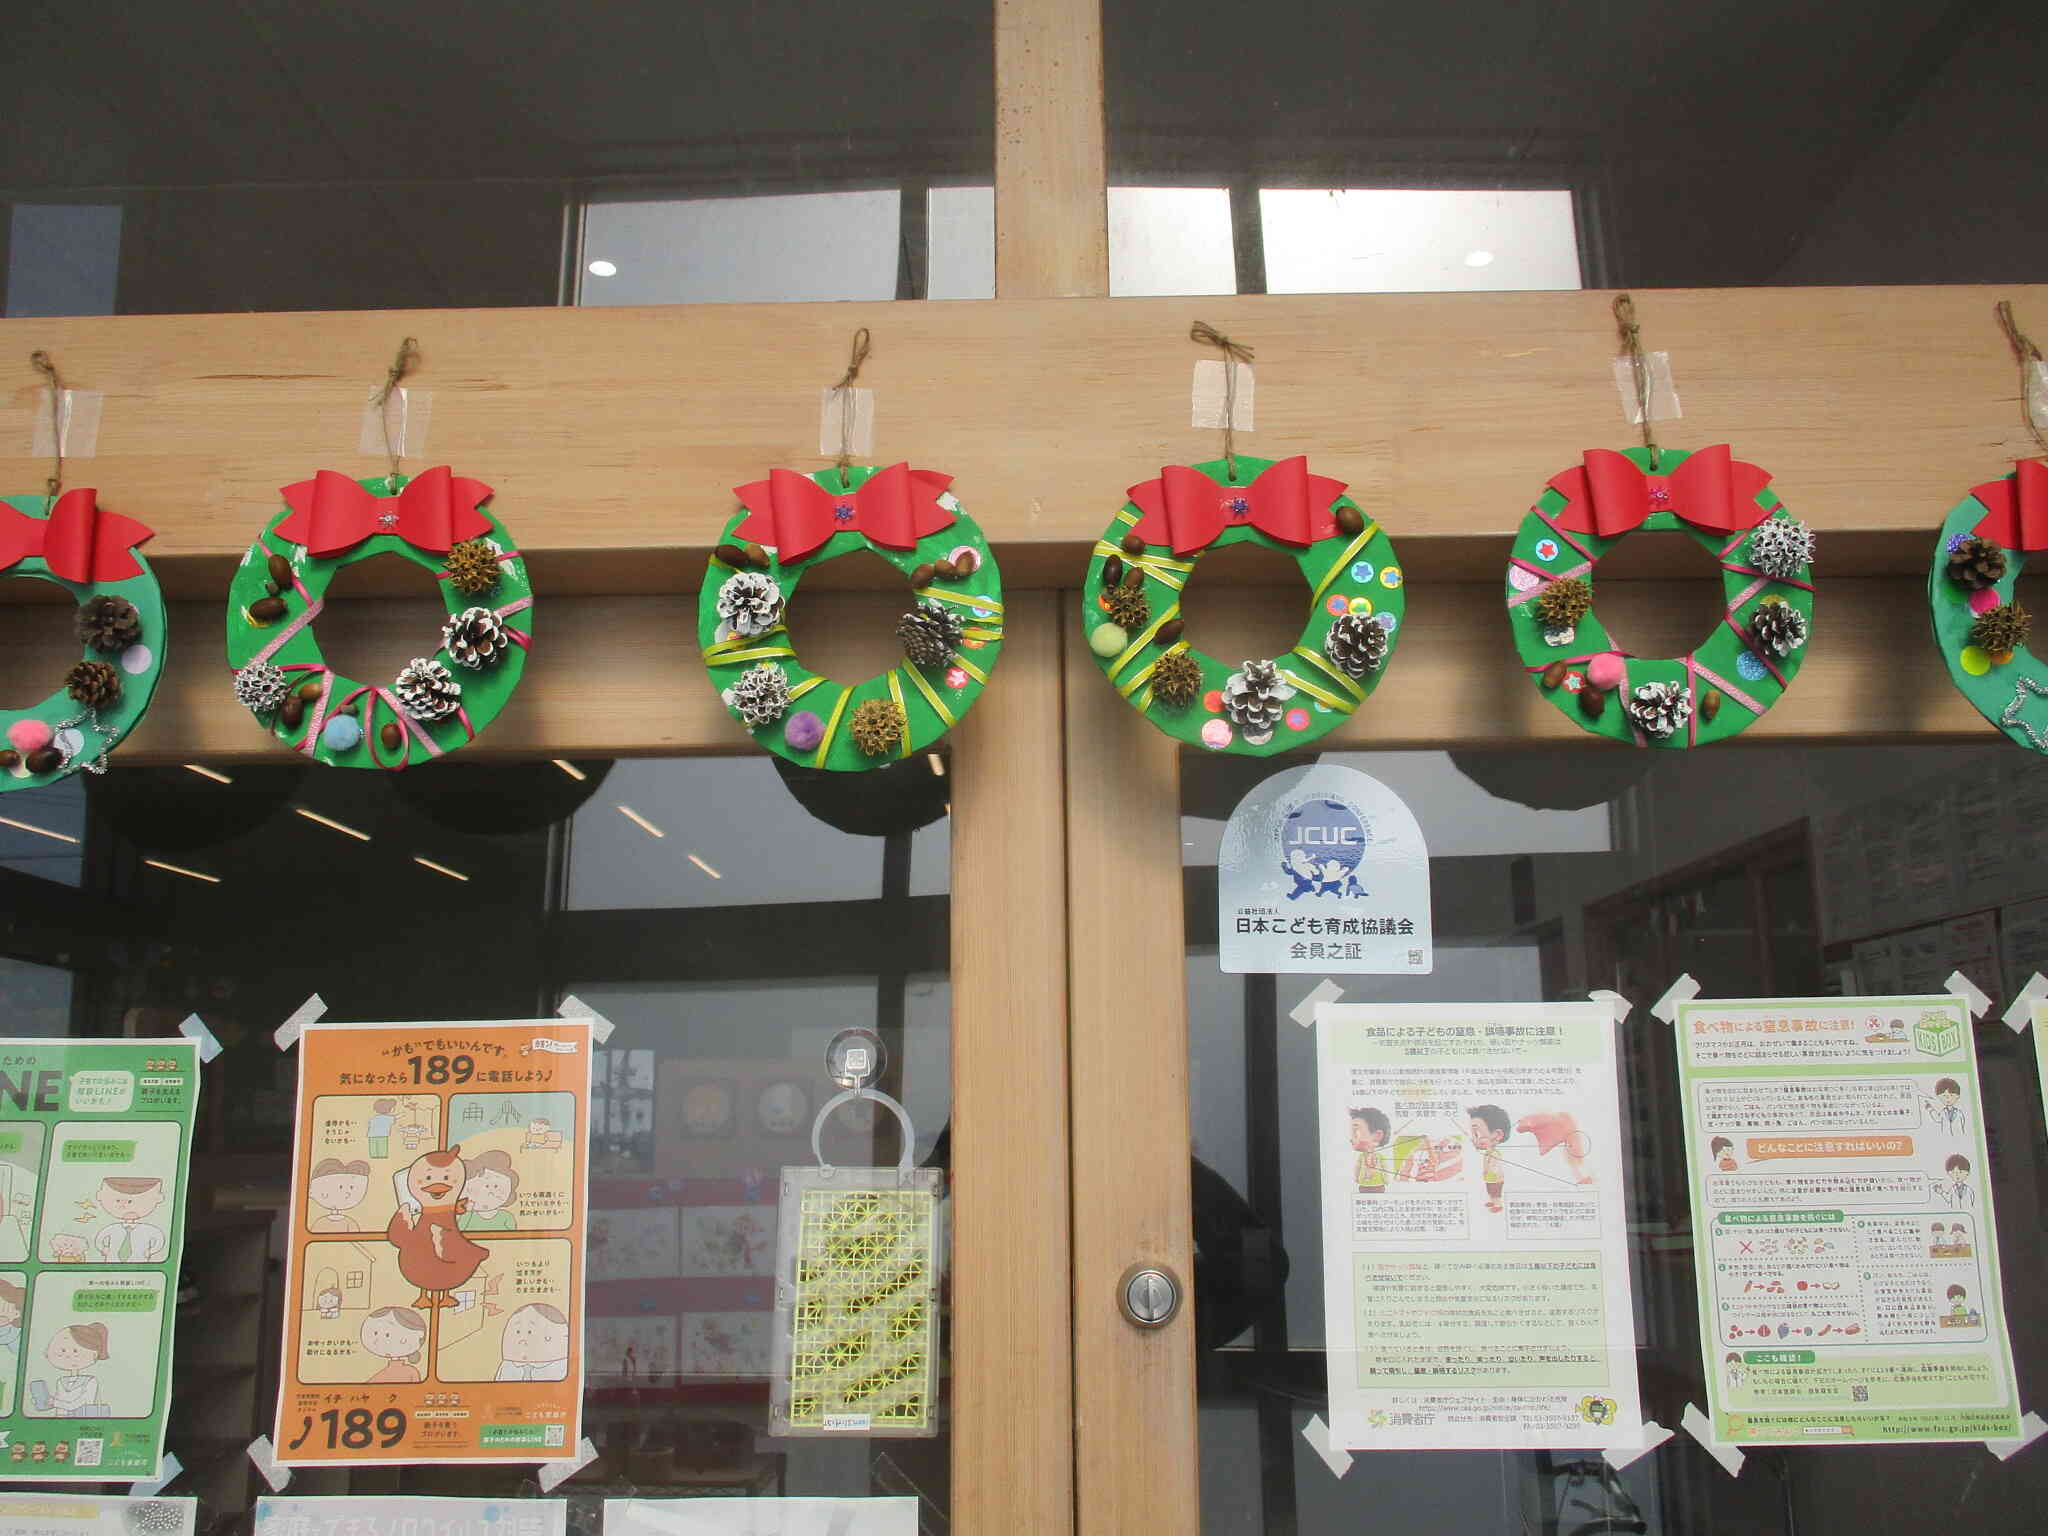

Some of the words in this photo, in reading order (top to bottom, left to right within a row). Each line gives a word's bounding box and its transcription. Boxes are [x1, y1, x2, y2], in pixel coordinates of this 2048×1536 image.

[1288, 826, 1358, 846] JCUC
[1235, 915, 1415, 936] 日本こども育成協議会
[1290, 940, 1363, 960] 会員之証
[1916, 1029, 1937, 1053] KIDS
[319, 1407, 408, 1450] 189
